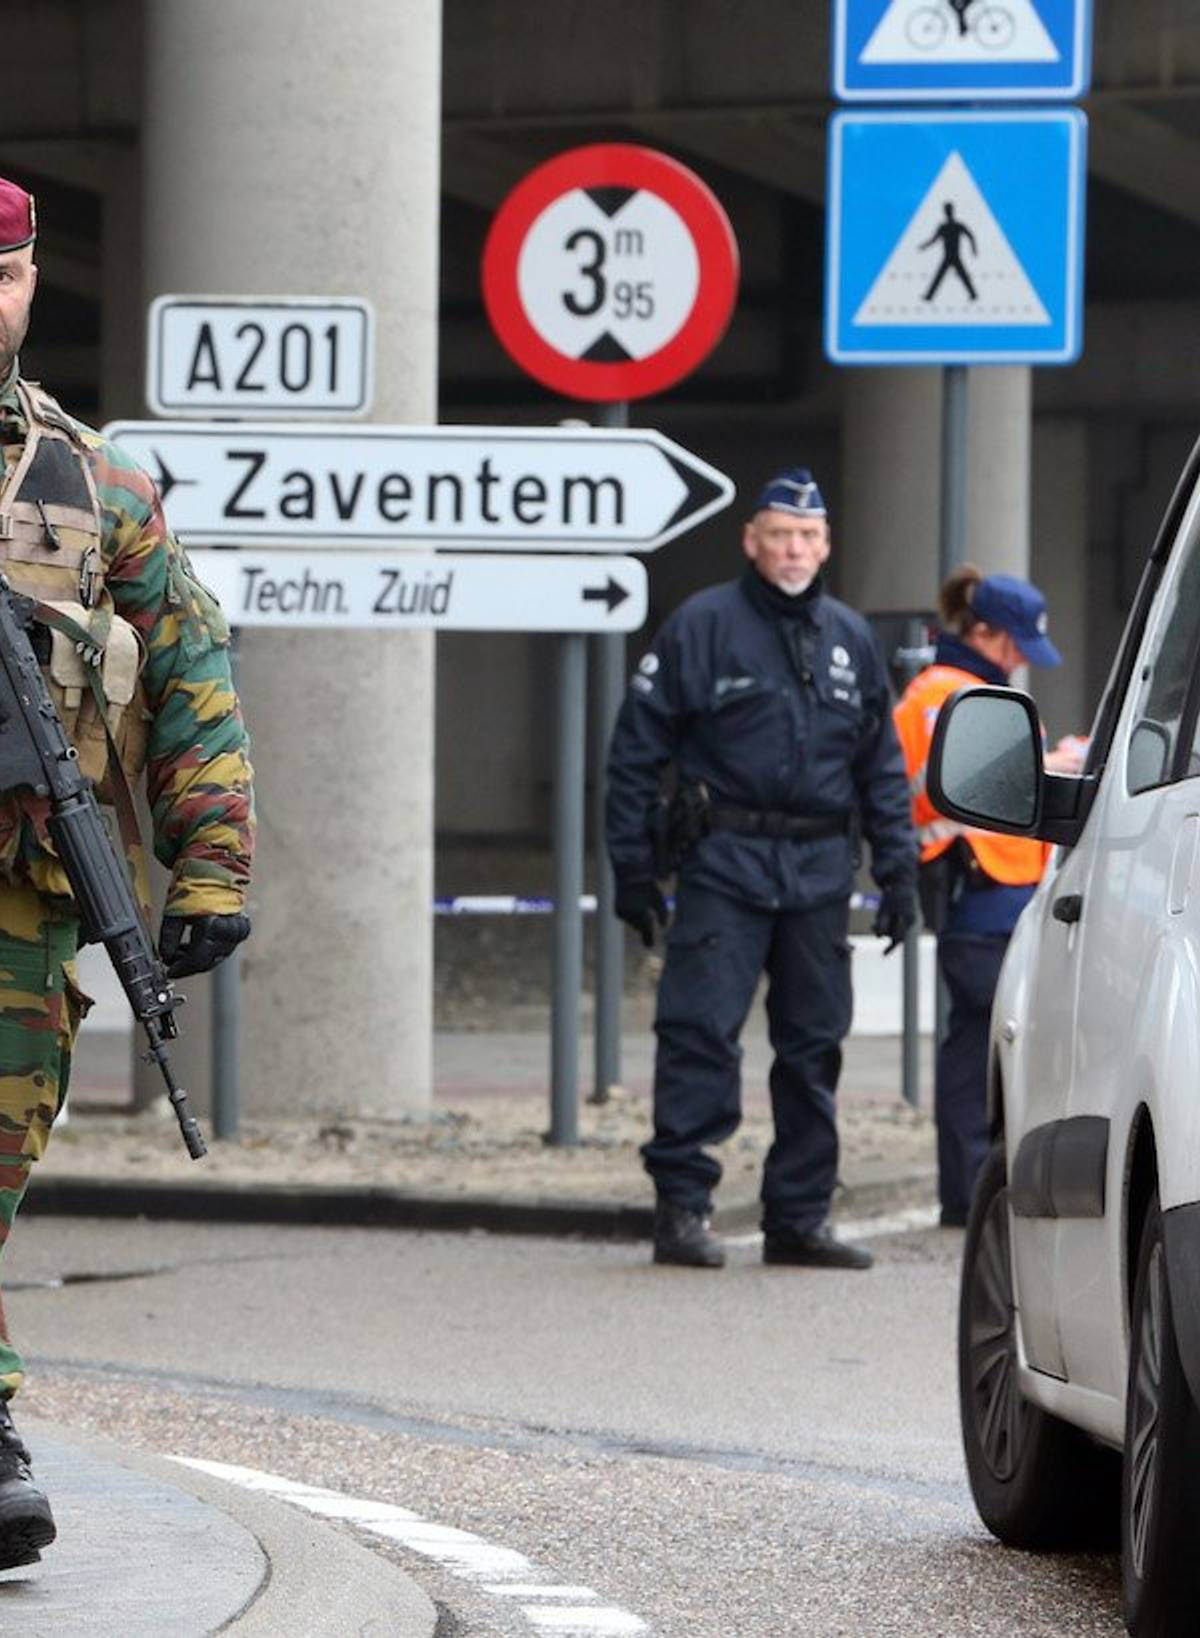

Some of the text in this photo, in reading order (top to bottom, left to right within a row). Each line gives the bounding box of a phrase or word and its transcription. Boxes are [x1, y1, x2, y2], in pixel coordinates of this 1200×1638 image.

[561, 227, 655, 321] 3 m 95
[185, 320, 340, 394] A201
[221, 450, 626, 526] Zaventem
[241, 566, 455, 617] Techn. Zuid
